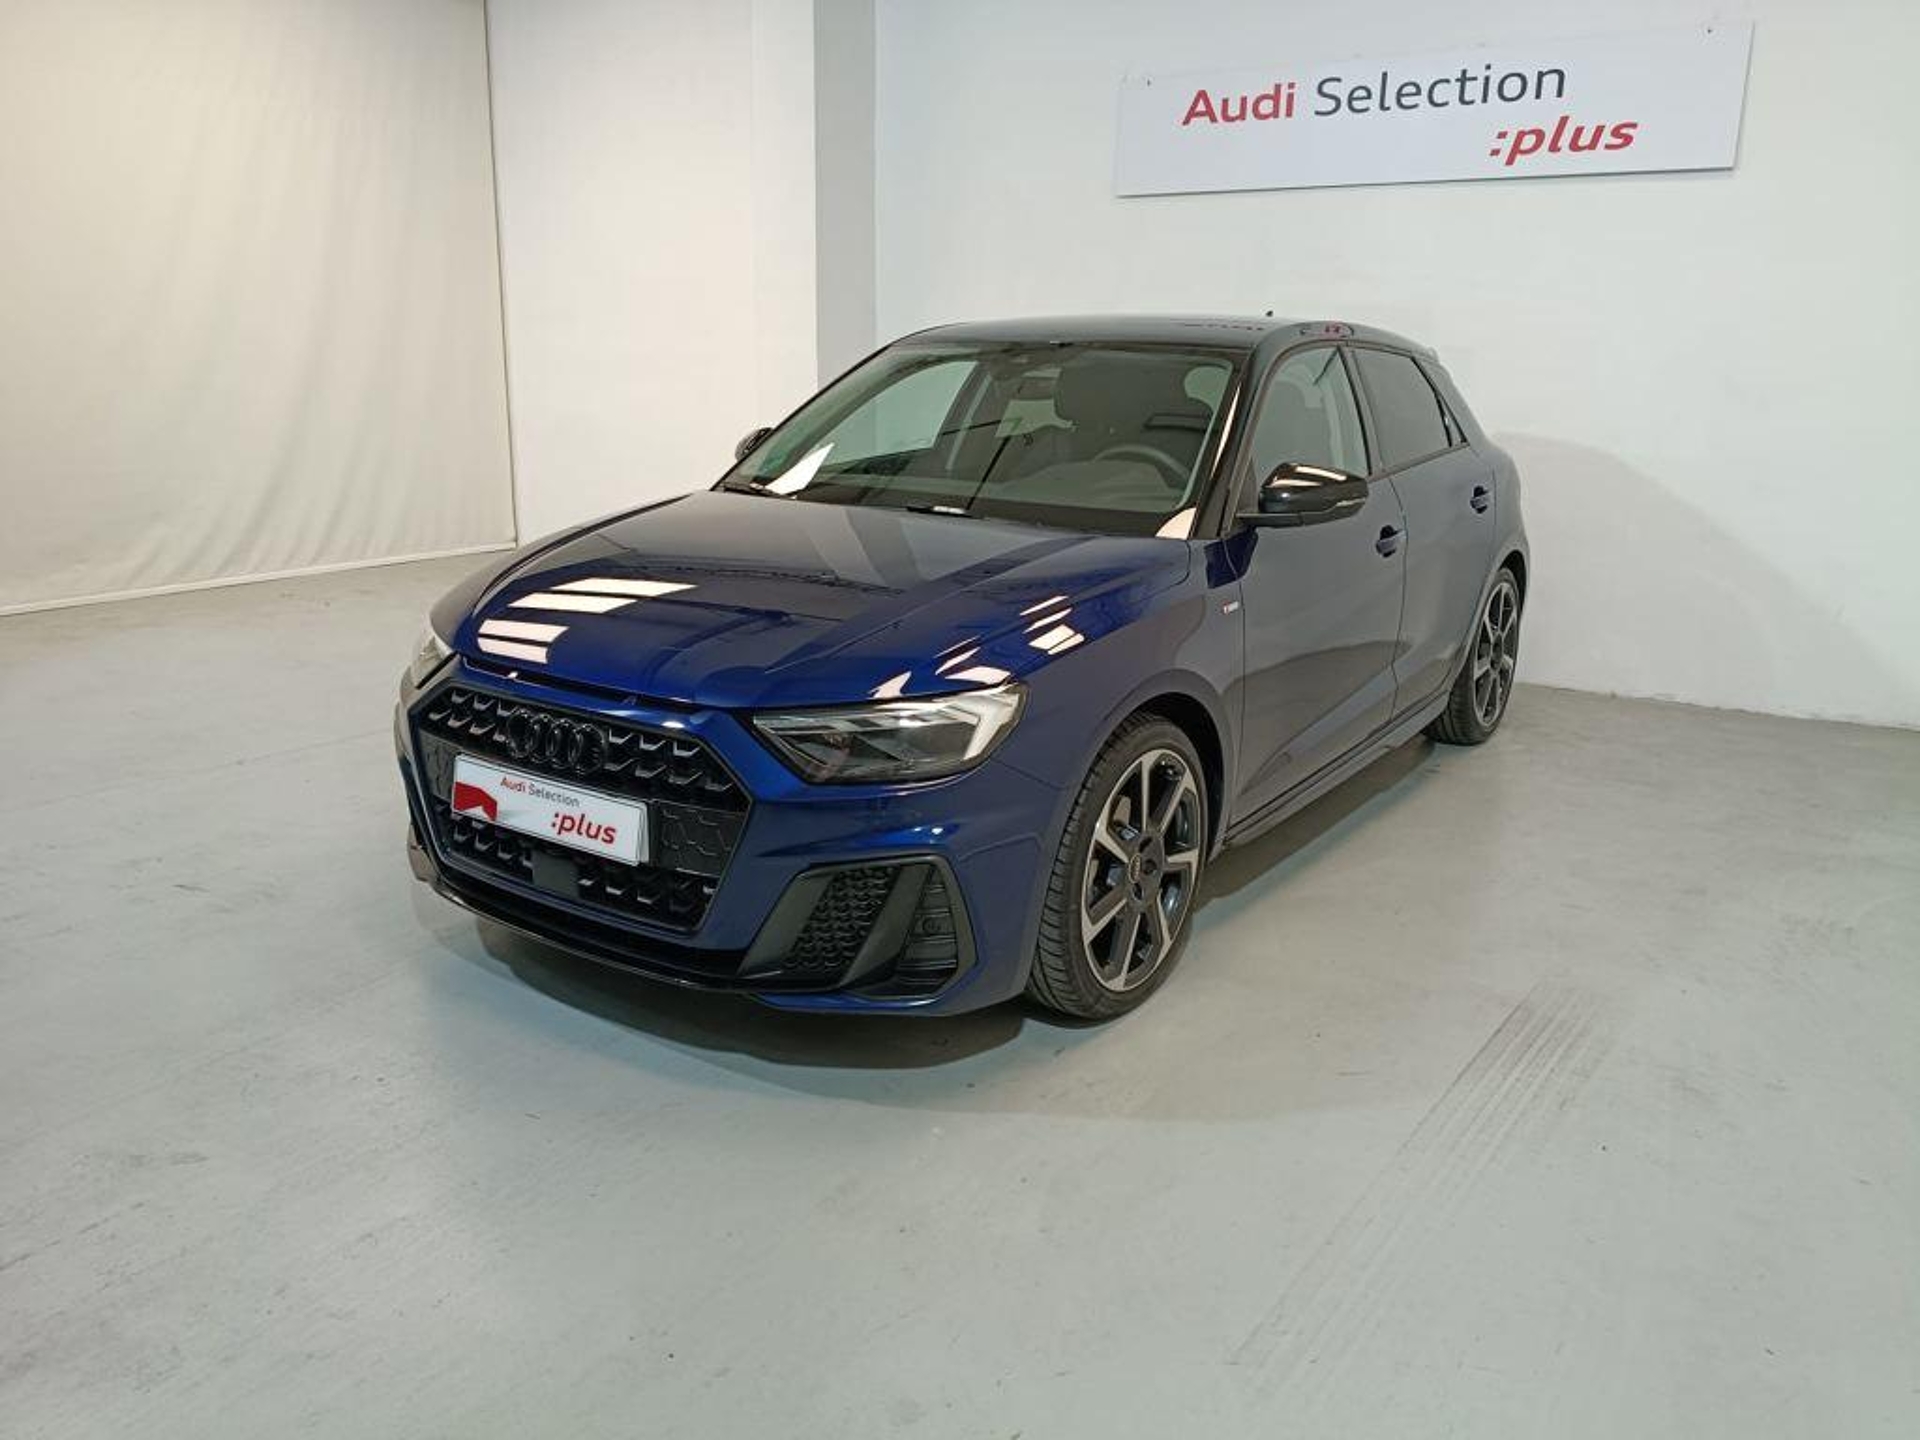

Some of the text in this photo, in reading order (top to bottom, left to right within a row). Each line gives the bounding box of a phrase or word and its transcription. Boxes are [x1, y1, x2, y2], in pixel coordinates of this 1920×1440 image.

[1182, 63, 1567, 126] Audi Selection
[1488, 115, 1639, 166] :plus
[500, 776, 580, 808] Audi Selection
[550, 812, 617, 844] :plus
